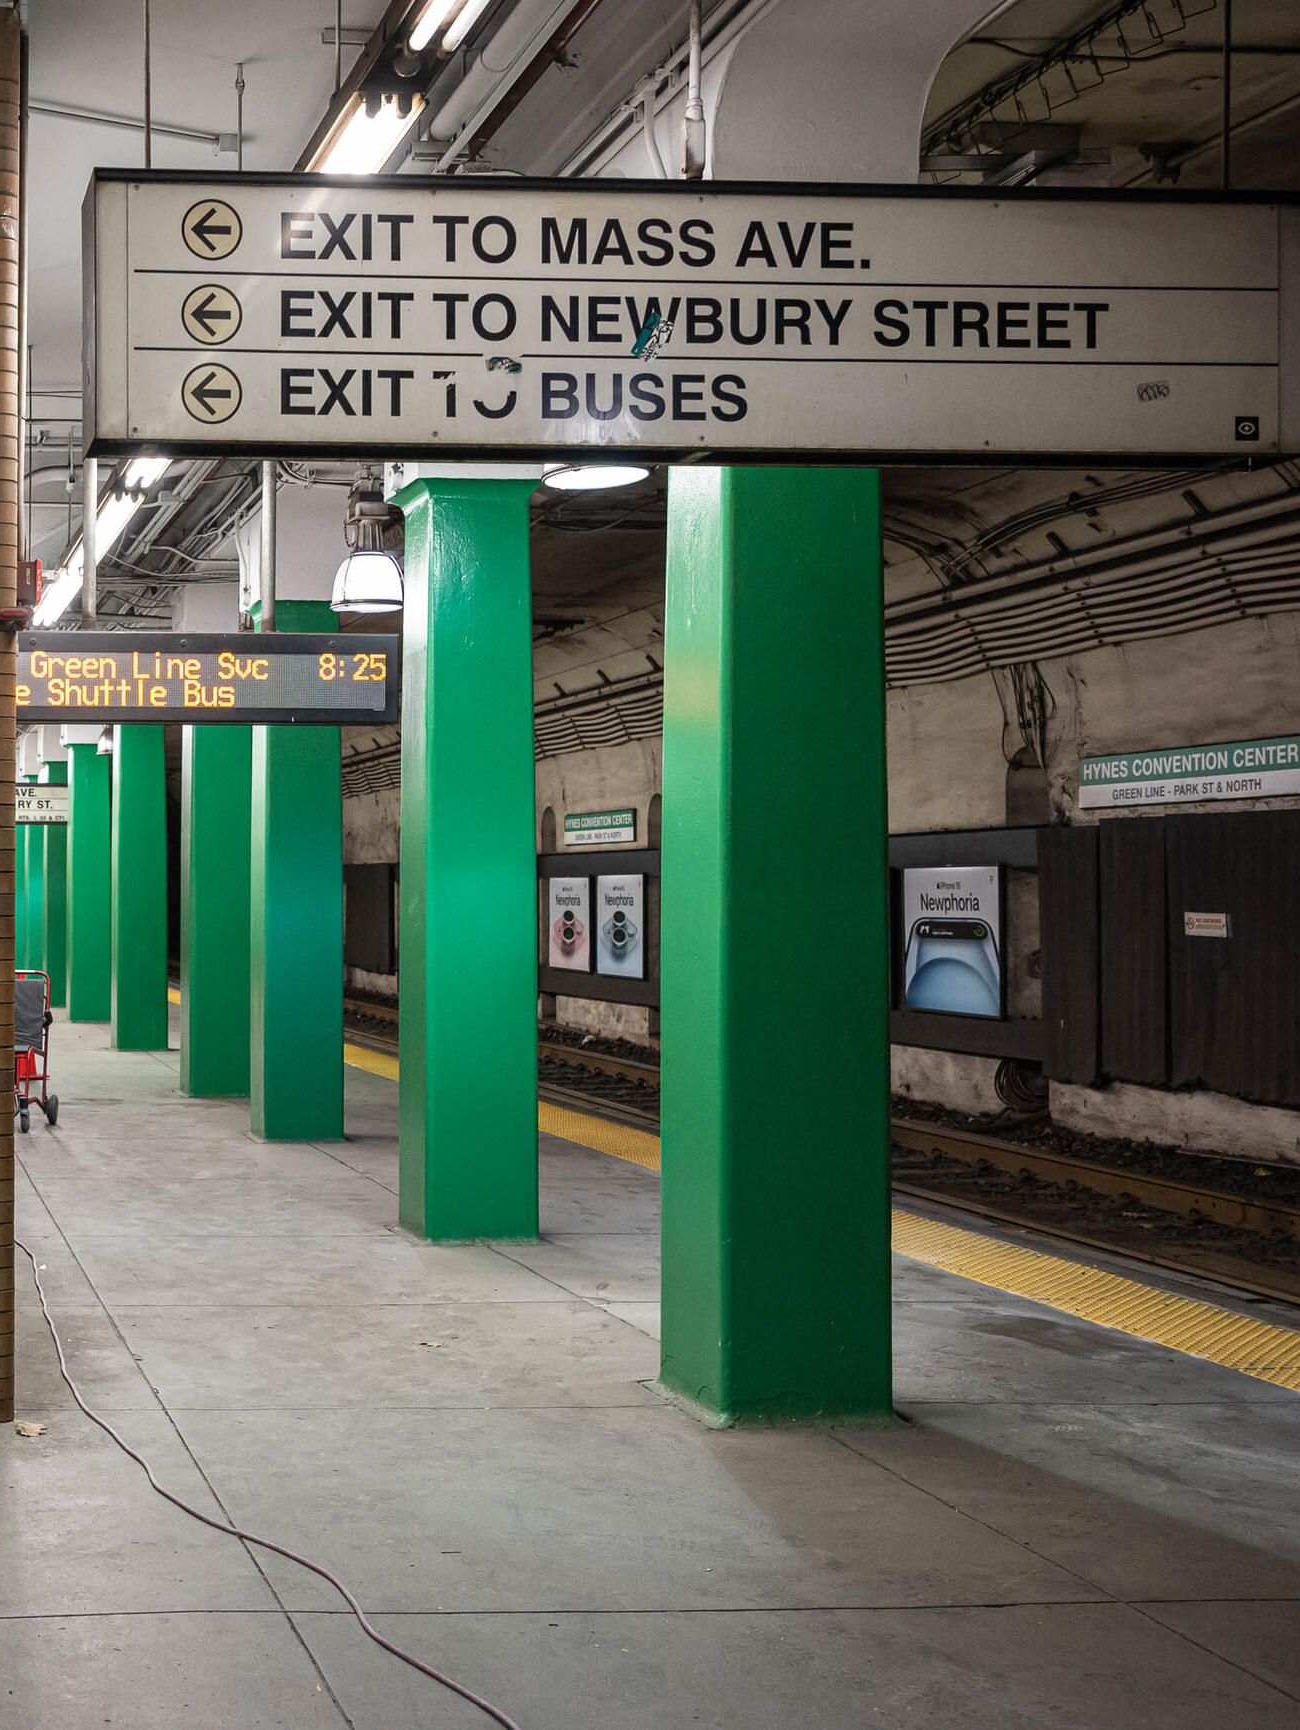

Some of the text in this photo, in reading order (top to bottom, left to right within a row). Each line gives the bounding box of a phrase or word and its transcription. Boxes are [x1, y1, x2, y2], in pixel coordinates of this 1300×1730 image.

[281, 212, 871, 270] EXIT TO MASS AVE.
[281, 290, 413, 339] EXIT
[432, 293, 517, 342] TO
[541, 294, 853, 346] NEWBURY
[873, 299, 1109, 349] STREET
[281, 368, 413, 417] EXIT
[541, 373, 748, 422] BUSES
[30, 650, 387, 682] Green Line Svc 8:25
[47, 678, 168, 707] Shuttle
[183, 679, 236, 708] Bus
[1083, 743, 1299, 780] HYNES CONVENTION CENTER
[37, 800, 53, 810] ST.
[1112, 787, 1143, 800] GREEN
[1145, 785, 1165, 798] LINE
[1174, 783, 1200, 796] PARK
[1202, 781, 1214, 794] ST
[1217, 781, 1223, 793] &
[1226, 778, 1262, 792] NORTH
[920, 892, 980, 916] Newphoria
